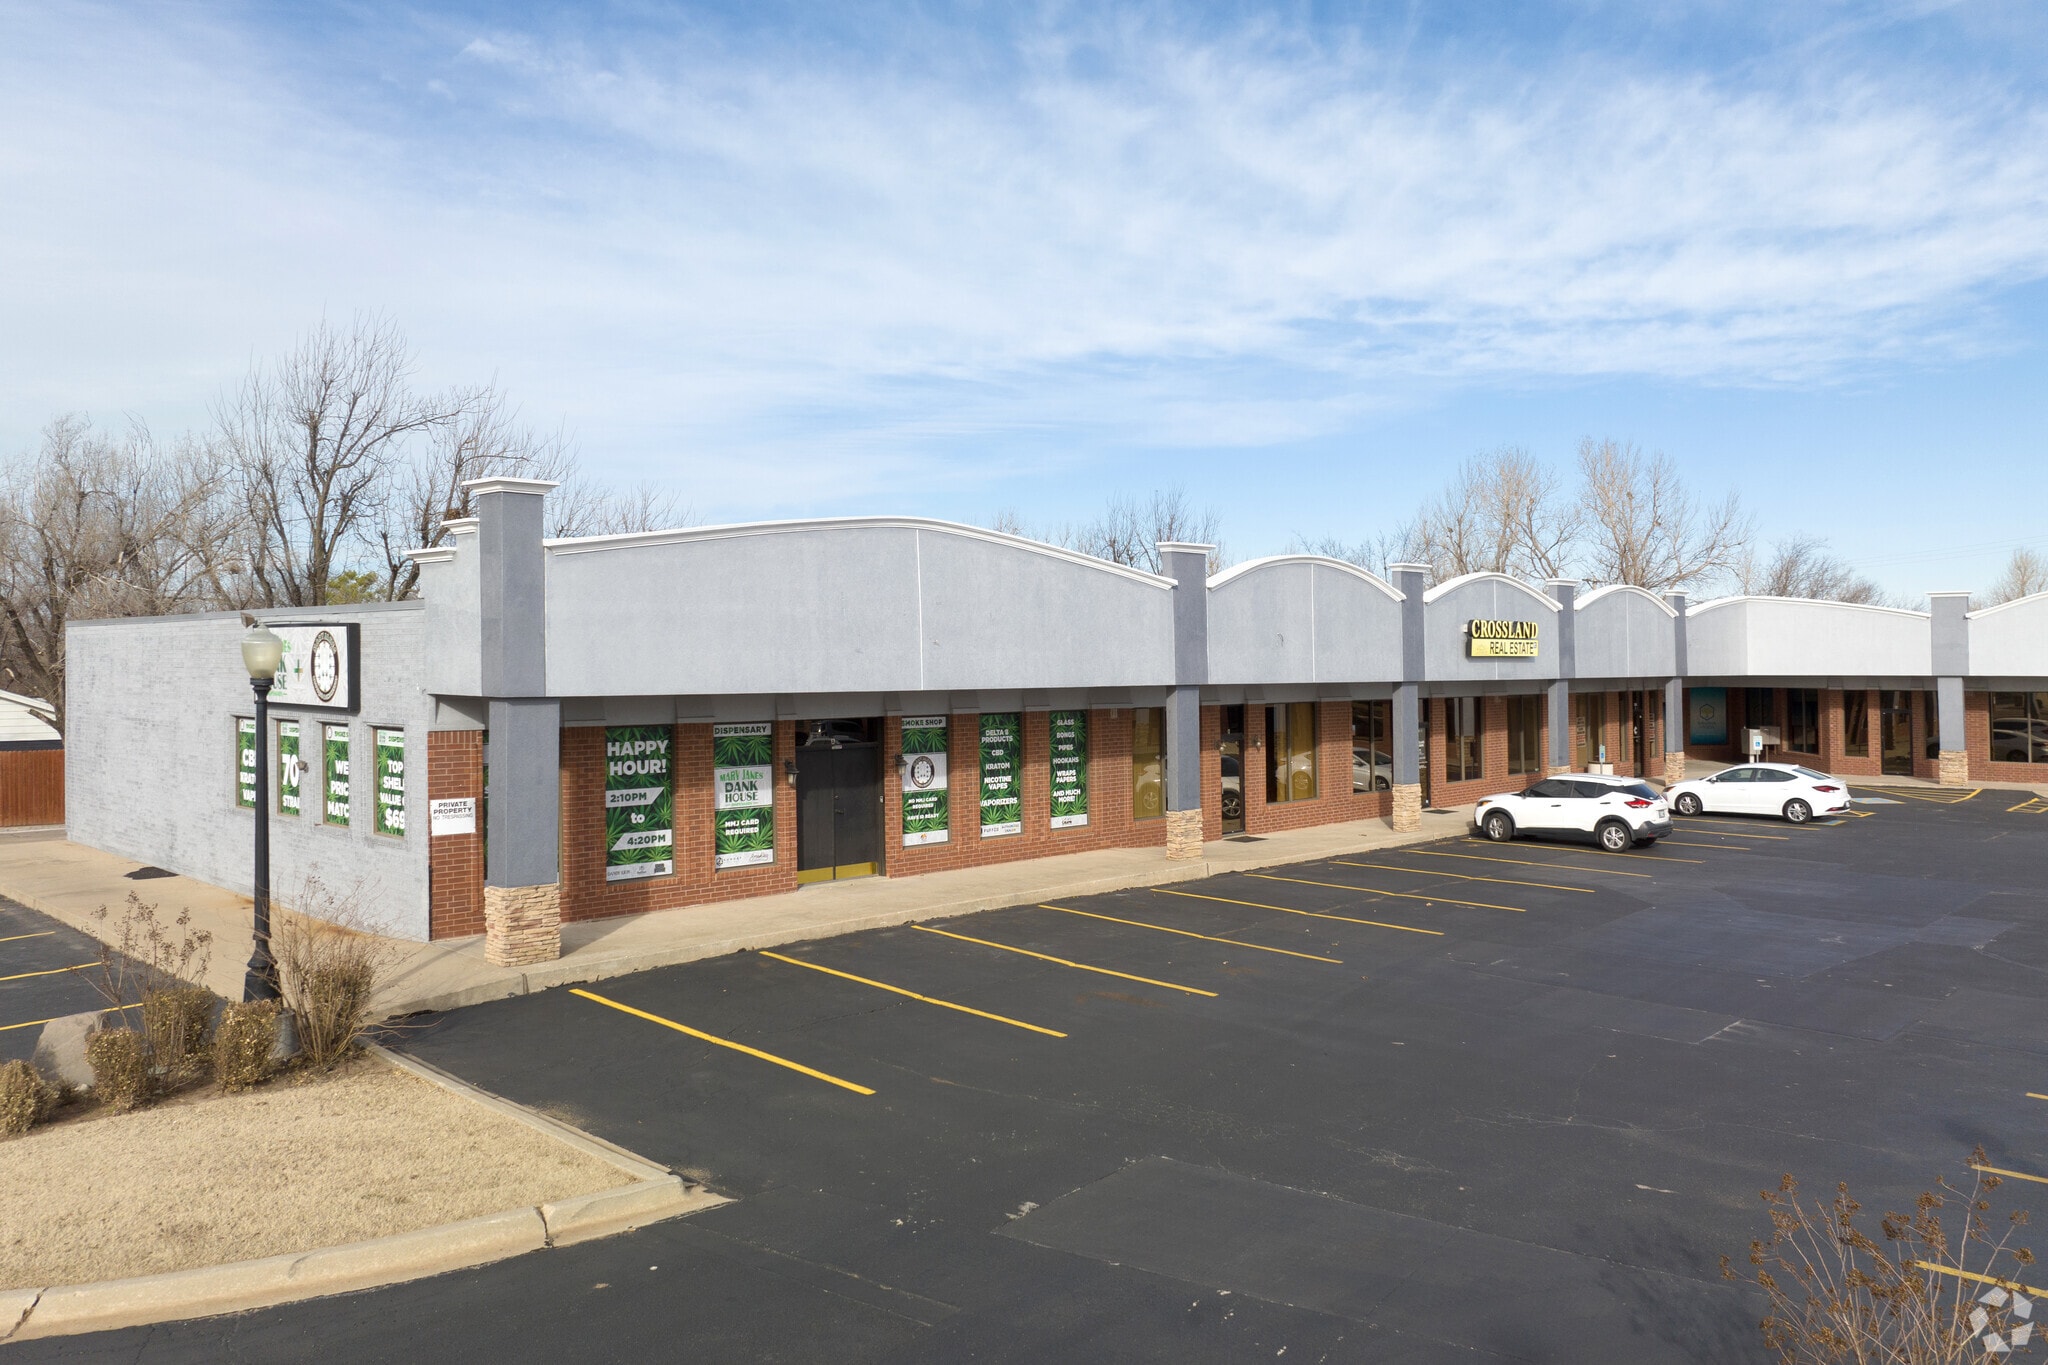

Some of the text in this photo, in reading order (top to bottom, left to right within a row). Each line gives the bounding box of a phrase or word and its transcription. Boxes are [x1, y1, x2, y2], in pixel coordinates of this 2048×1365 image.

[1472, 620, 1538, 639] CROSSLAND
[1490, 641, 1534, 654] REAL ESTATE
[607, 740, 669, 757] HAPPY
[387, 760, 404, 774] TOP
[609, 759, 667, 776] HOUR!
[720, 769, 764, 782] MARY JANES
[984, 776, 1012, 784] NICOTINE
[330, 780, 349, 797] PRIC
[383, 776, 405, 791] SHEL
[724, 780, 759, 793] DANK
[380, 792, 402, 806] VALUE
[610, 792, 647, 803] 2:10PM
[725, 792, 758, 803] HOUSE
[980, 797, 1018, 807] VAPORIZERS
[327, 801, 350, 818] MATC
[433, 807, 473, 815] PROPERTY
[630, 812, 646, 824] to
[724, 820, 740, 828] MMJ
[725, 827, 759, 836] REQUIRED
[627, 834, 667, 846] 4:20PM
